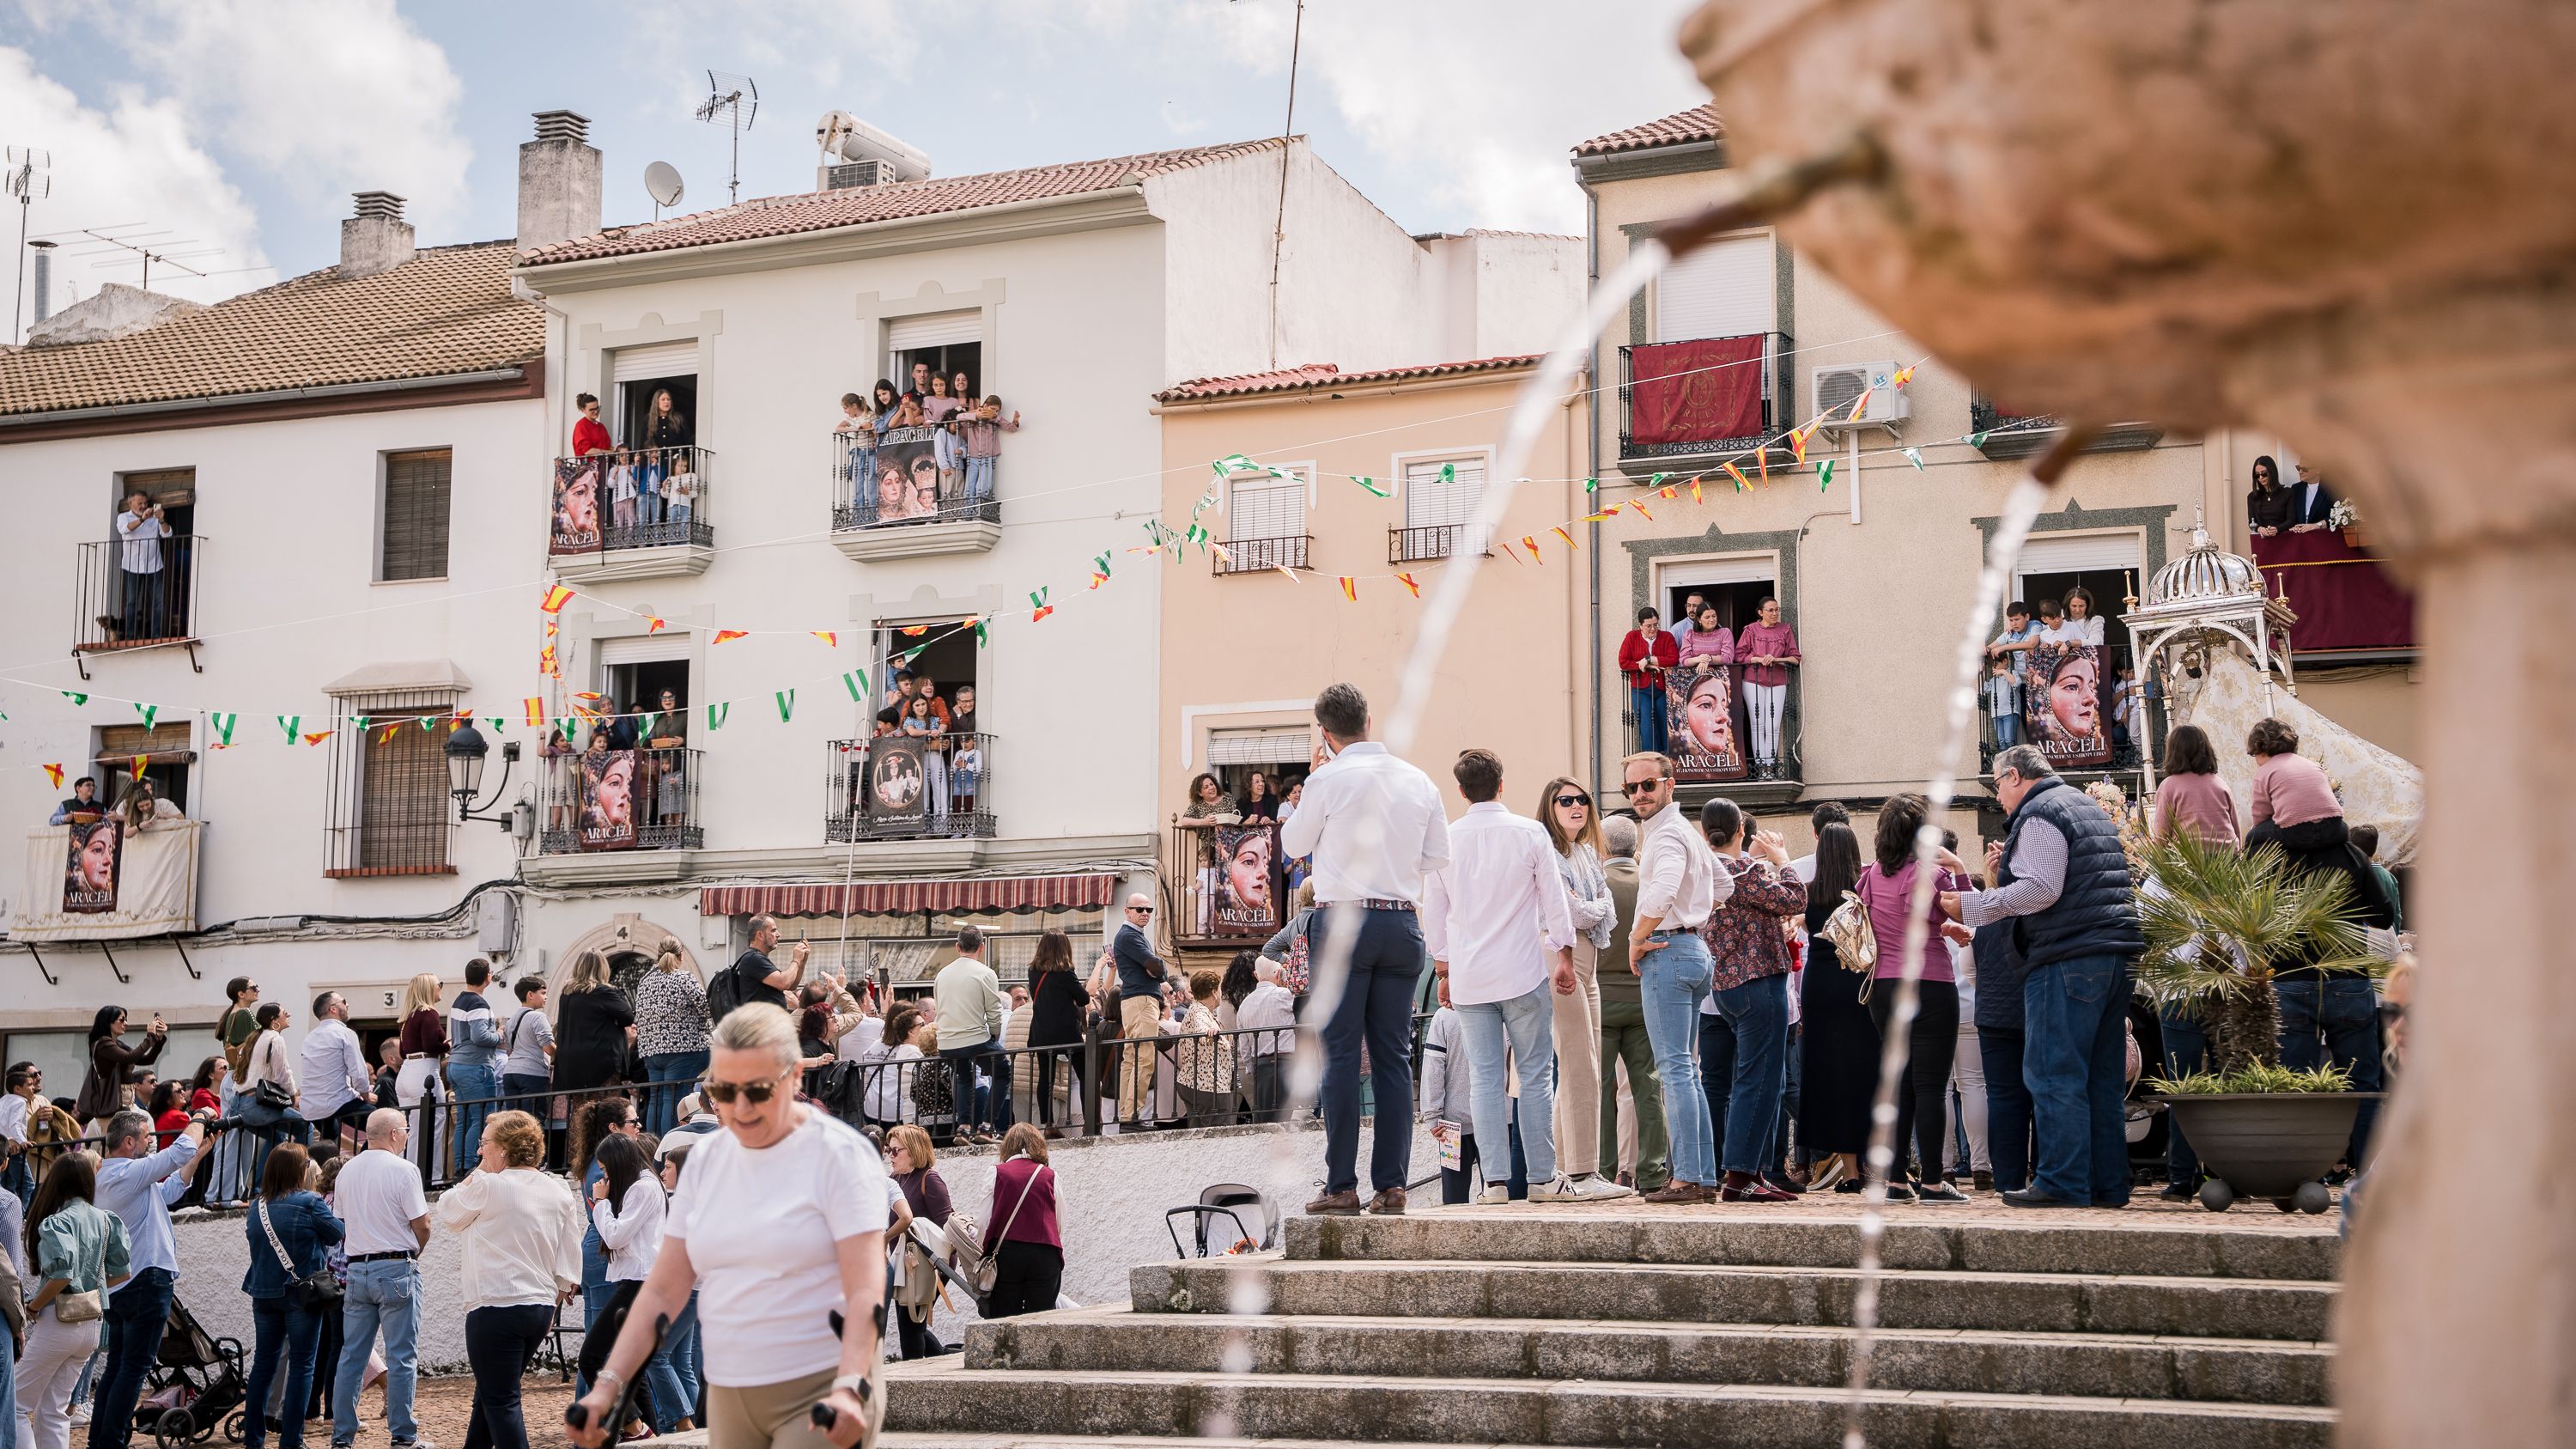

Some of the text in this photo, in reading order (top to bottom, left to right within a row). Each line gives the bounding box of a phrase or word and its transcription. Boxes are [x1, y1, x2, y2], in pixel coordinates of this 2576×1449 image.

[880, 427, 935, 446] ARACELI
[554, 529, 600, 545] ARACELI
[2037, 736, 2105, 754] ARACELI
[1675, 752, 1740, 768] ARACELI
[584, 825, 633, 839] ARACELI
[68, 889, 112, 903] ARACELI
[1218, 908, 1274, 922] ARACELI
[617, 927, 628, 940] 4
[385, 993, 394, 1006] 3
[278, 1248, 289, 1266] LOLA
